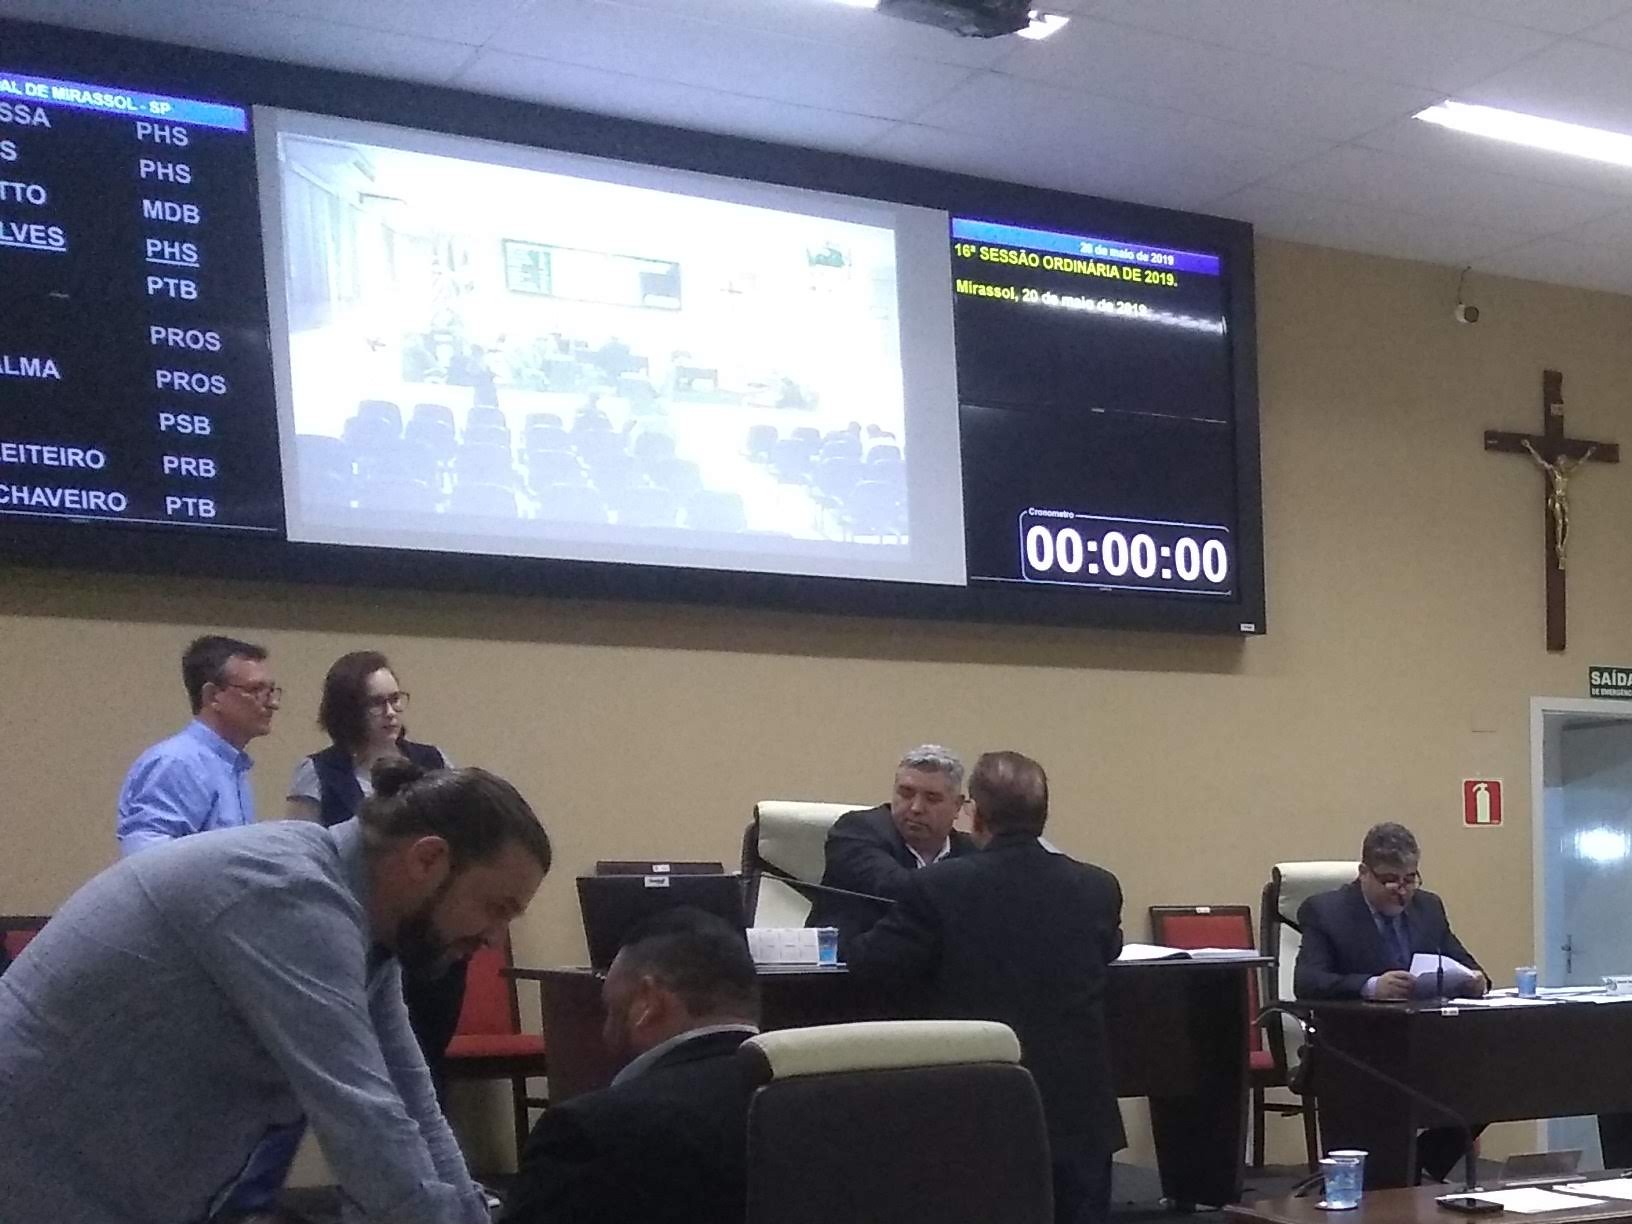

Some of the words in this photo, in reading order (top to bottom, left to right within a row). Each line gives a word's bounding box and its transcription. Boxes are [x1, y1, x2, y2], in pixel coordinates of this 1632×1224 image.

[25, 82, 49, 98] DE
[52, 86, 138, 111] MIRASSOL
[149, 101, 172, 115] SP
[0, 102, 51, 128] SSA
[136, 121, 189, 147] PHS
[139, 159, 192, 184] PHS
[142, 199, 201, 225] MDB
[146, 238, 199, 263] PHS
[1150, 252, 1175, 266] 2019
[979, 246, 1040, 268] SESSÃO
[1042, 255, 1120, 279] ORDINÁRIA
[1122, 266, 1142, 282] DE
[1144, 270, 1178, 287] 2019.
[147, 276, 198, 300] PTB
[956, 279, 1019, 302] Mirassol,
[1022, 288, 1039, 303] 20
[1041, 291, 1059, 306] de
[150, 325, 222, 351] PROS
[0, 355, 61, 379] LMA
[156, 370, 227, 395] PROS
[159, 412, 211, 435] PSB
[0, 442, 105, 470] EITEIRO
[163, 455, 217, 478] PRB
[0, 483, 128, 512] CHAVEIRO
[166, 496, 217, 518] PTB
[1026, 525, 1228, 583] 00:00:00
